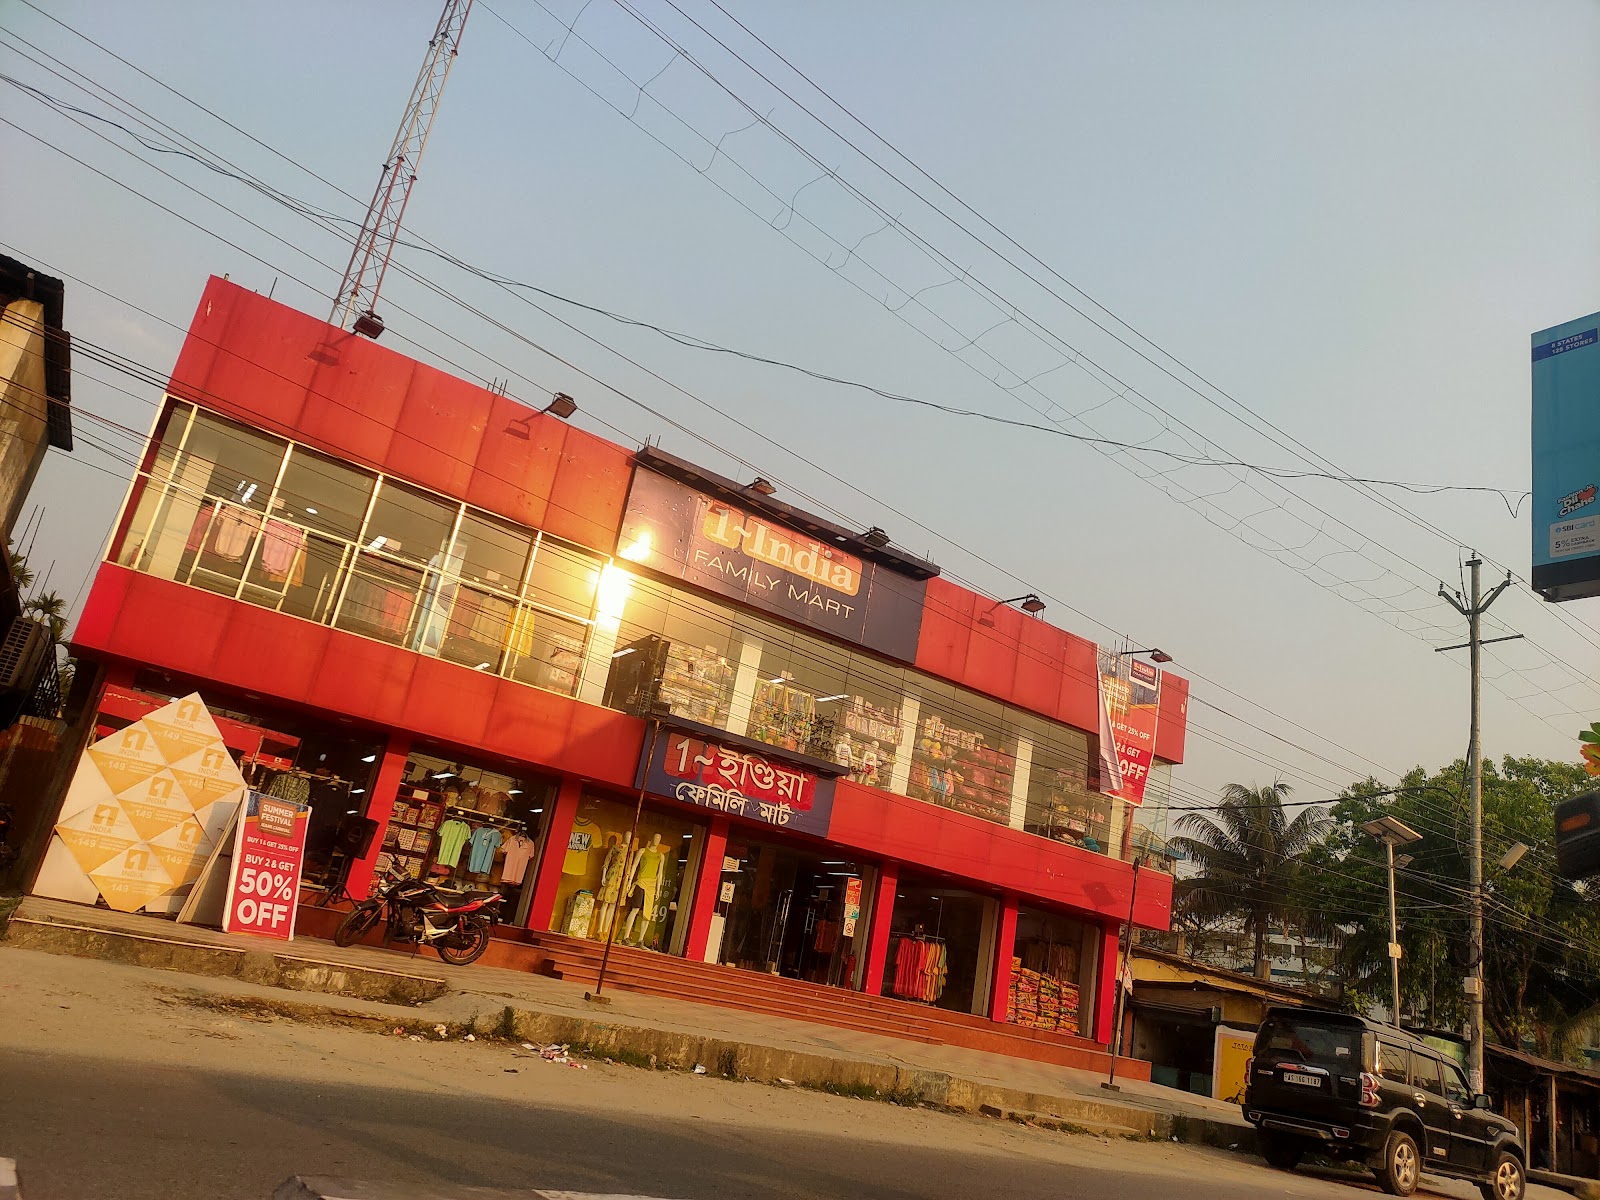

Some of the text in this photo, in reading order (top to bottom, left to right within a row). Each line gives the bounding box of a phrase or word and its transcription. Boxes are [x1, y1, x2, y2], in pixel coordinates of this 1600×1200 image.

[1557, 334, 1583, 347] STATES
[1565, 337, 1593, 351] STORES
[1559, 496, 1595, 516] Chahe
[1563, 494, 1579, 508] Dil
[1562, 519, 1595, 532] SBI card
[1554, 538, 1570, 549] 5%
[694, 548, 855, 619] FAMILY MART
[1116, 722, 1128, 732] GET
[1139, 731, 1151, 741] OFF
[1126, 746, 1141, 759] GET
[1119, 758, 1147, 781] OFF
[262, 804, 294, 819] SUMMER
[260, 812, 292, 827] FESTIVAL
[246, 835, 259, 845] BUY
[266, 840, 279, 849] GET
[288, 844, 299, 853] OFF
[570, 832, 591, 846] NEW
[245, 853, 295, 872] BUY 2 & GET
[238, 867, 293, 901] 50%
[236, 898, 290, 929] OFF
